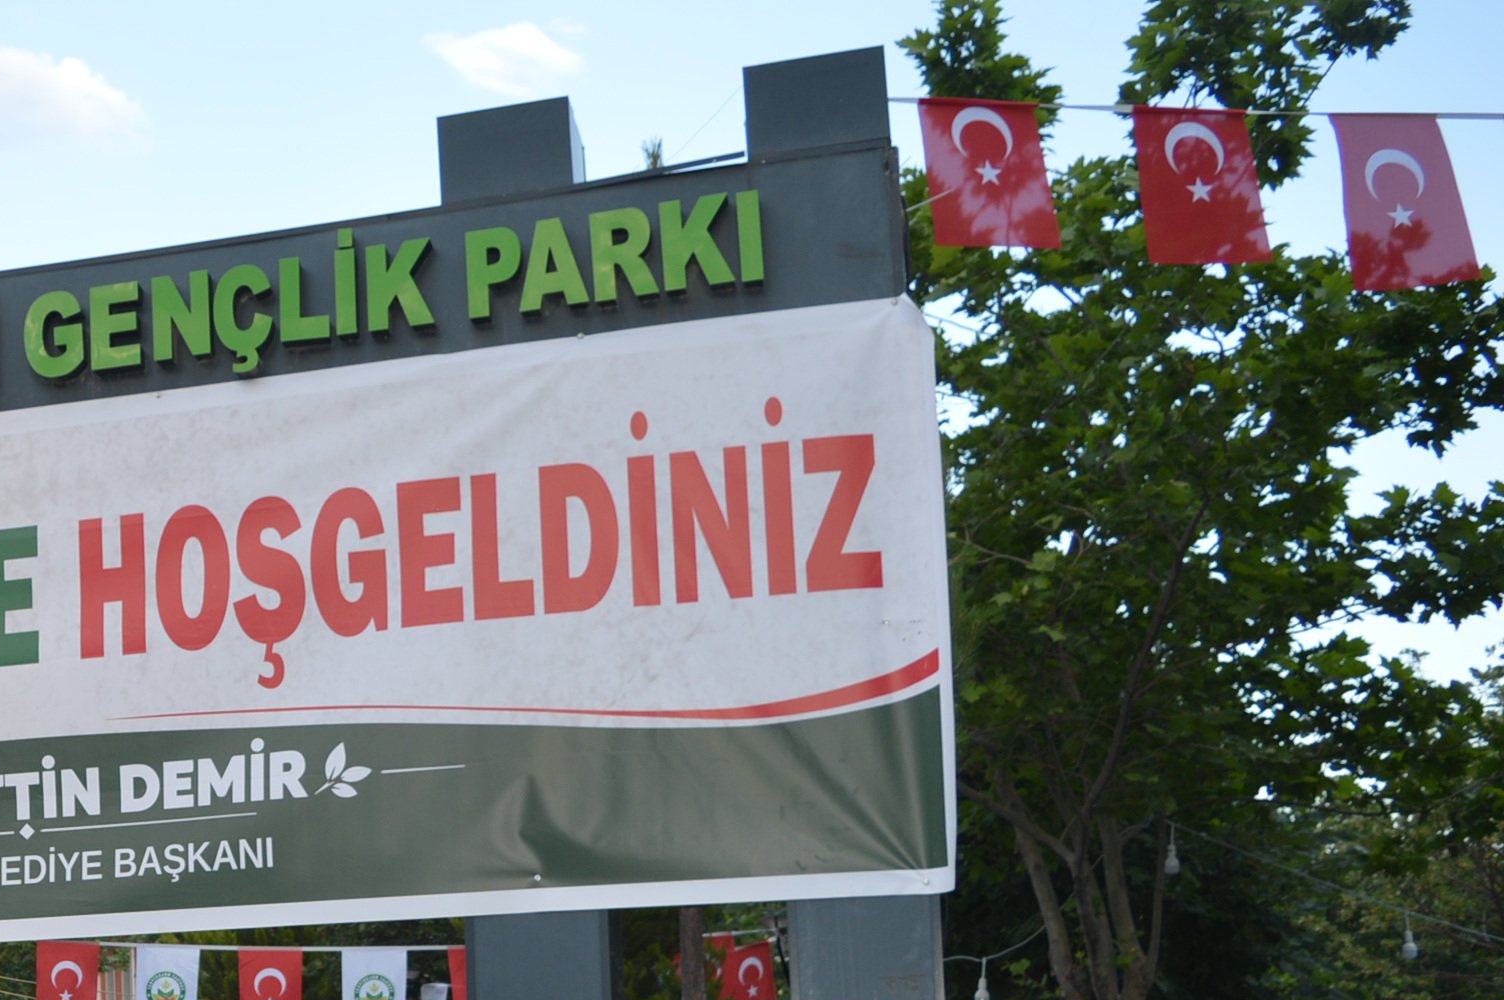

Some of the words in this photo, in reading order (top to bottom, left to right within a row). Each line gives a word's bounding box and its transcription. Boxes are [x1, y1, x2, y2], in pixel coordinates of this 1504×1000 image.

[22, 227, 436, 374] GENÇLİK
[464, 189, 766, 322] PARKI
[78, 396, 885, 690] HOŞGELDİNİZ
[119, 737, 308, 814] DEMİR
[114, 836, 275, 883] BAŞKANI
